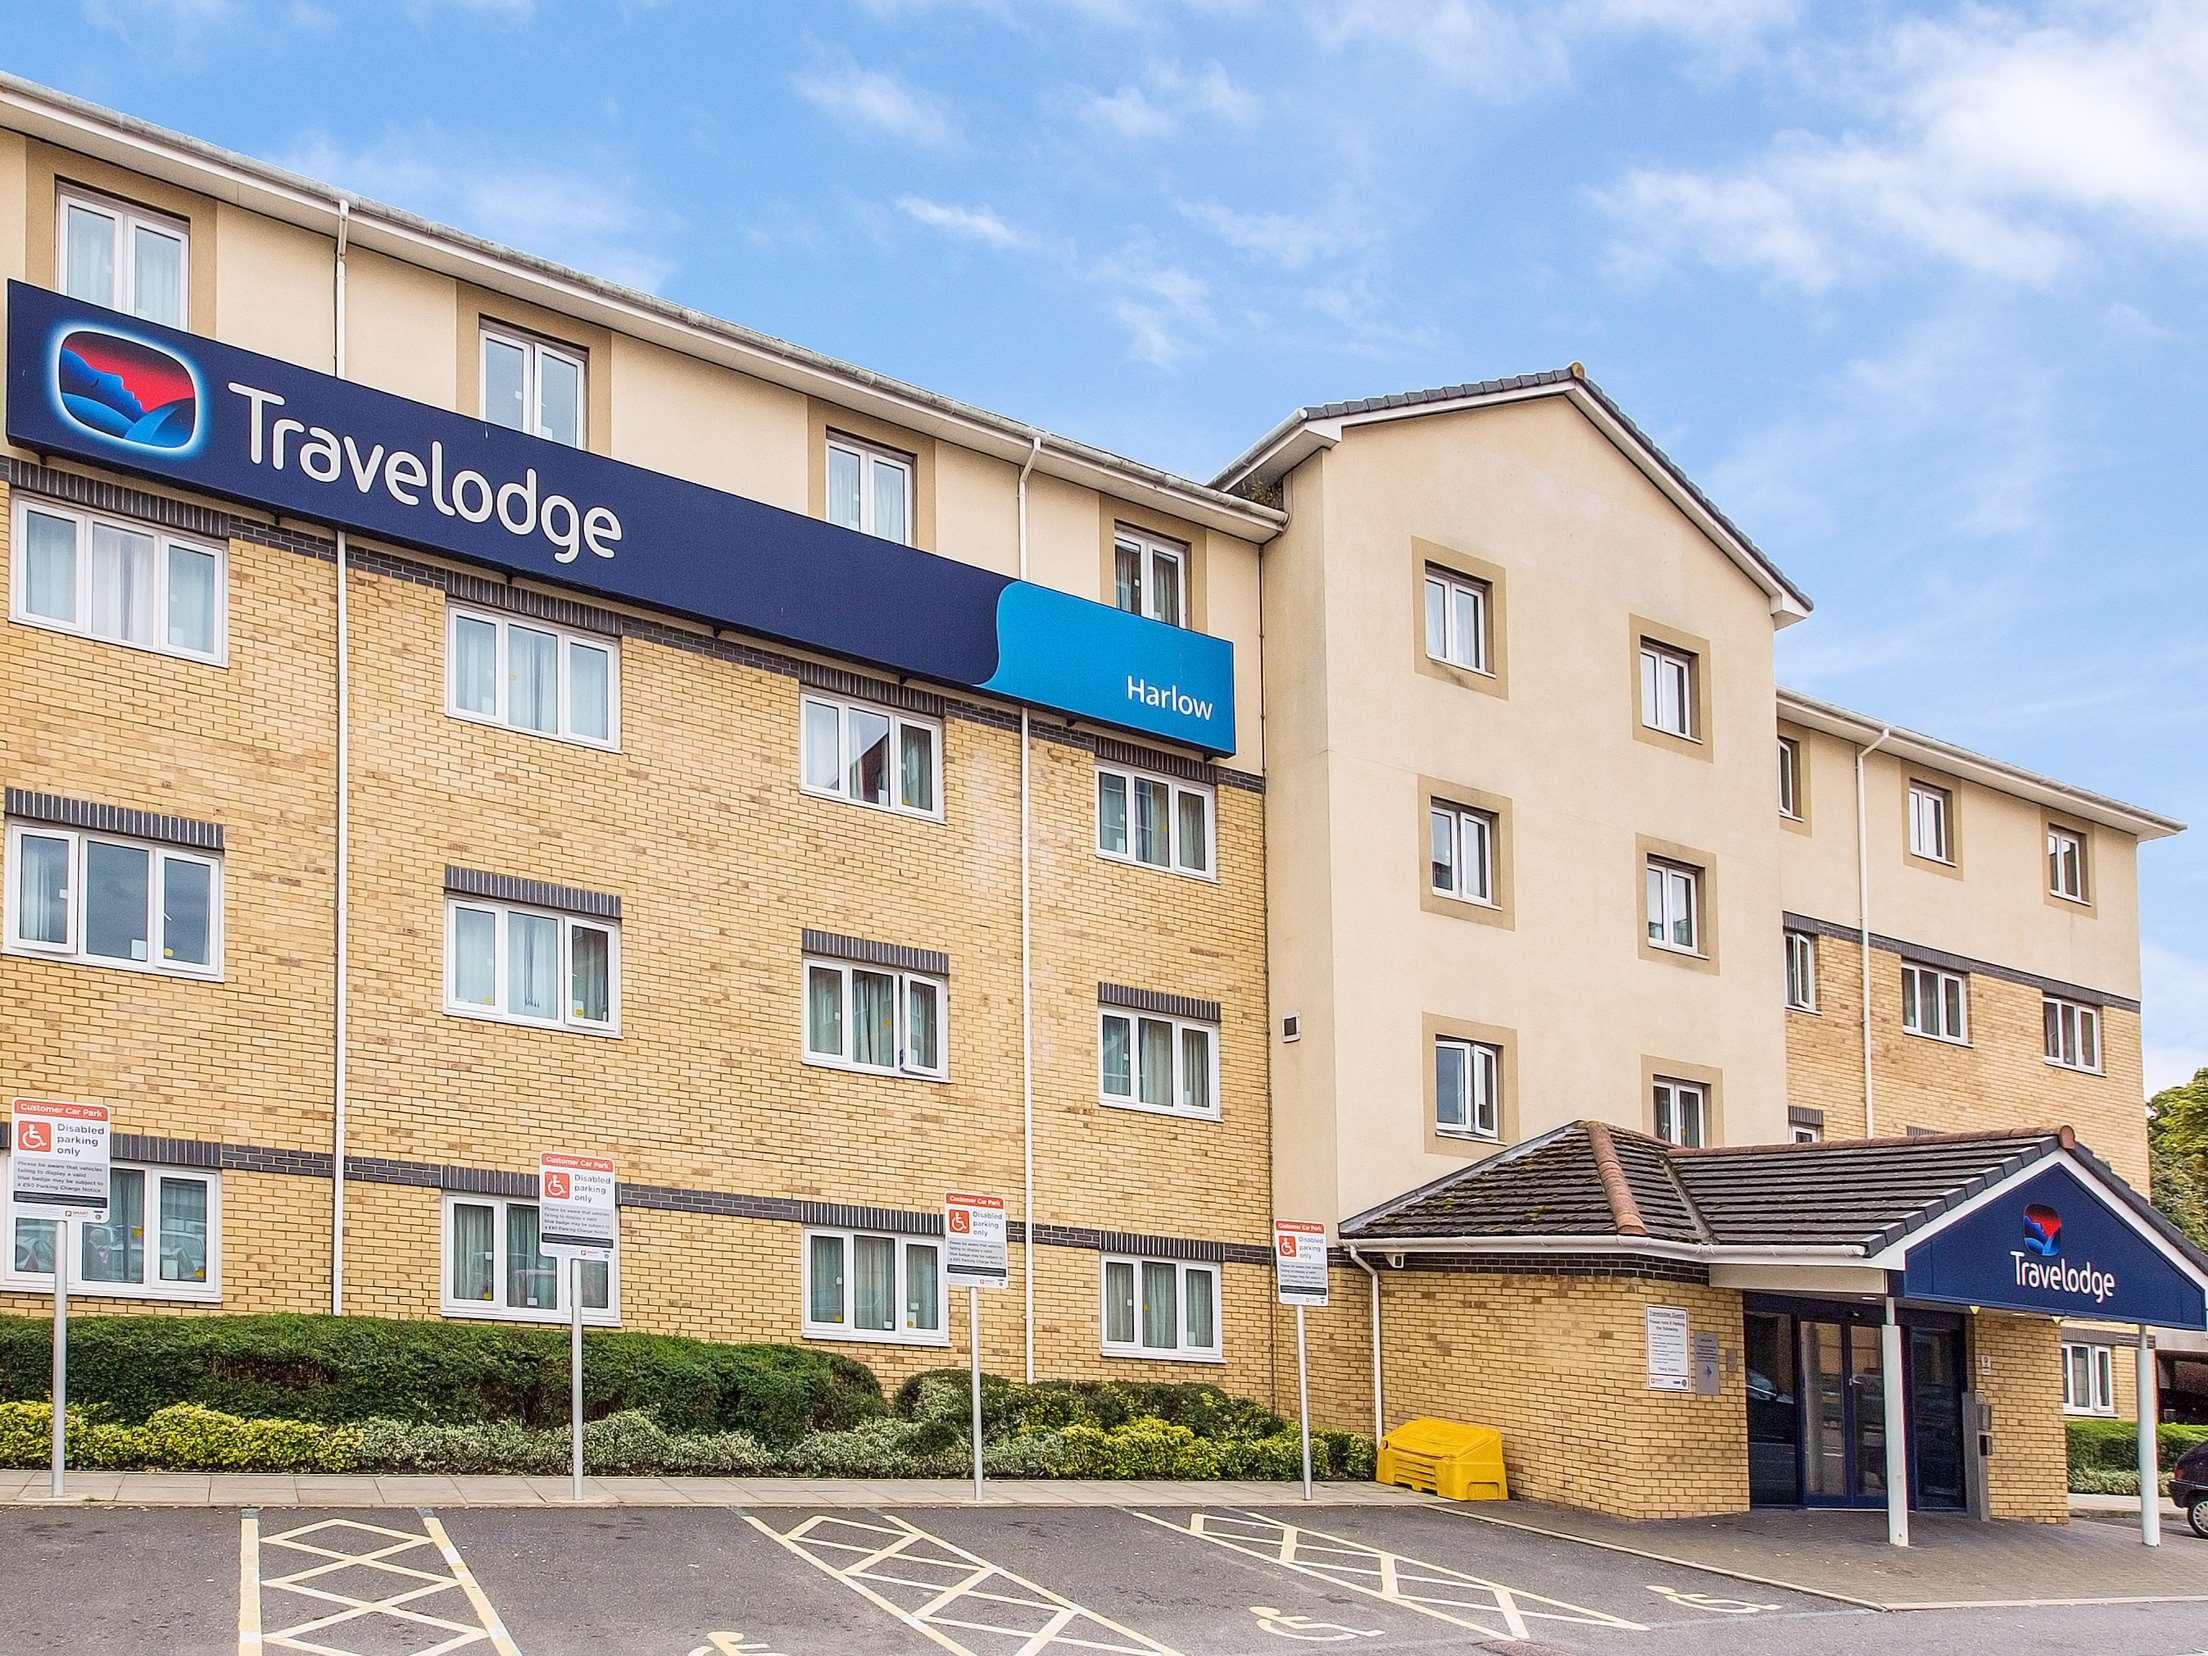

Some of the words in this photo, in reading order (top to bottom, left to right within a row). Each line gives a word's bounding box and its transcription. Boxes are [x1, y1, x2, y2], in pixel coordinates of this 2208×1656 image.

[226, 381, 624, 564] Travelodge
[1127, 675, 1213, 721] Harlow
[20, 1103, 63, 1114] Customer
[64, 1107, 81, 1115] Car
[83, 1109, 103, 1117] Park
[57, 1123, 105, 1135] Disabled
[57, 1136, 99, 1147] parking
[57, 1147, 81, 1157] only
[545, 1156, 579, 1166] Customer
[574, 1174, 611, 1184] Disabled
[574, 1186, 607, 1194] parking
[574, 1195, 592, 1203] only
[973, 1211, 1002, 1219] Disabled
[973, 1221, 999, 1229] parking
[2010, 1250, 2116, 1304] Travelodge
